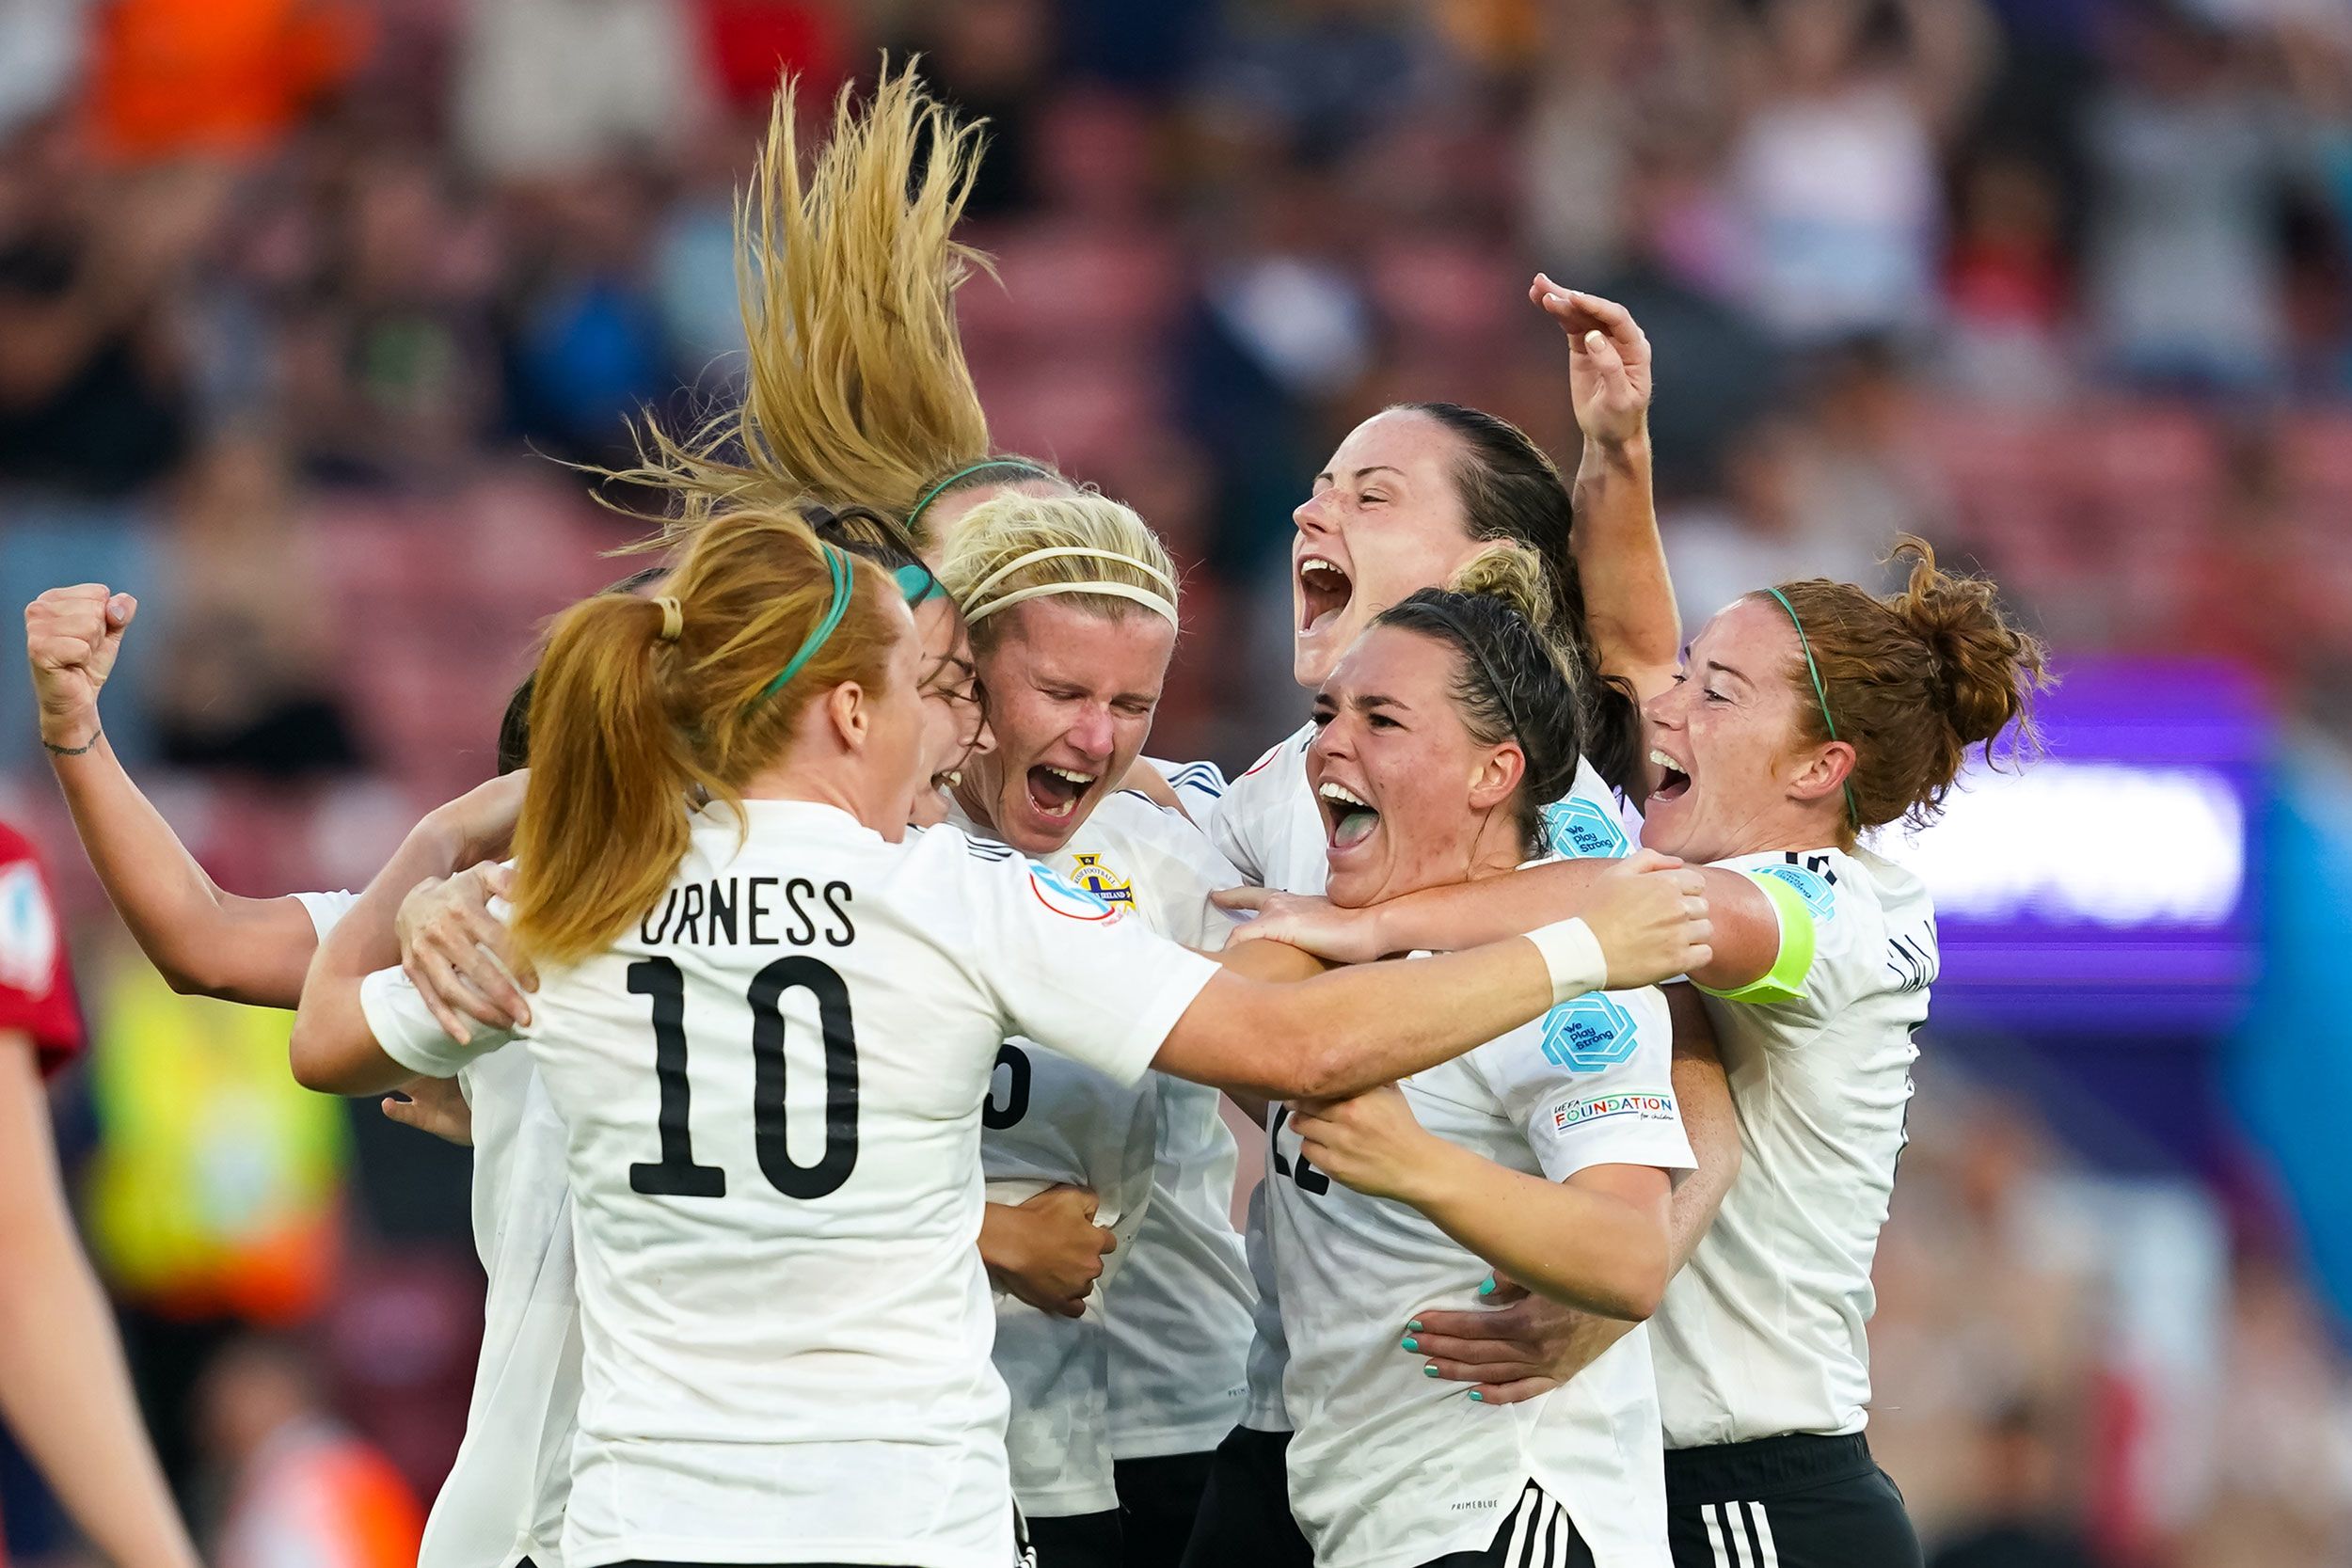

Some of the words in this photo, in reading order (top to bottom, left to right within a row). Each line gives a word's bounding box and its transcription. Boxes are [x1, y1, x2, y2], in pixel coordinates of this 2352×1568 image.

[1565, 825, 1584, 835] We
[1573, 832, 1597, 845] Play
[1580, 839, 1613, 852] Strong
[641, 878, 855, 947] URNESS
[1564, 1022, 1582, 1033] We
[1570, 1026, 1597, 1042] Play
[1575, 1030, 1614, 1051] Strong
[628, 956, 859, 1199] 10
[1554, 1099, 1580, 1114] UEFA
[1555, 1098, 1672, 1126] FOUNDATION
[1452, 1499, 1498, 1511] PRIMEBLUE
